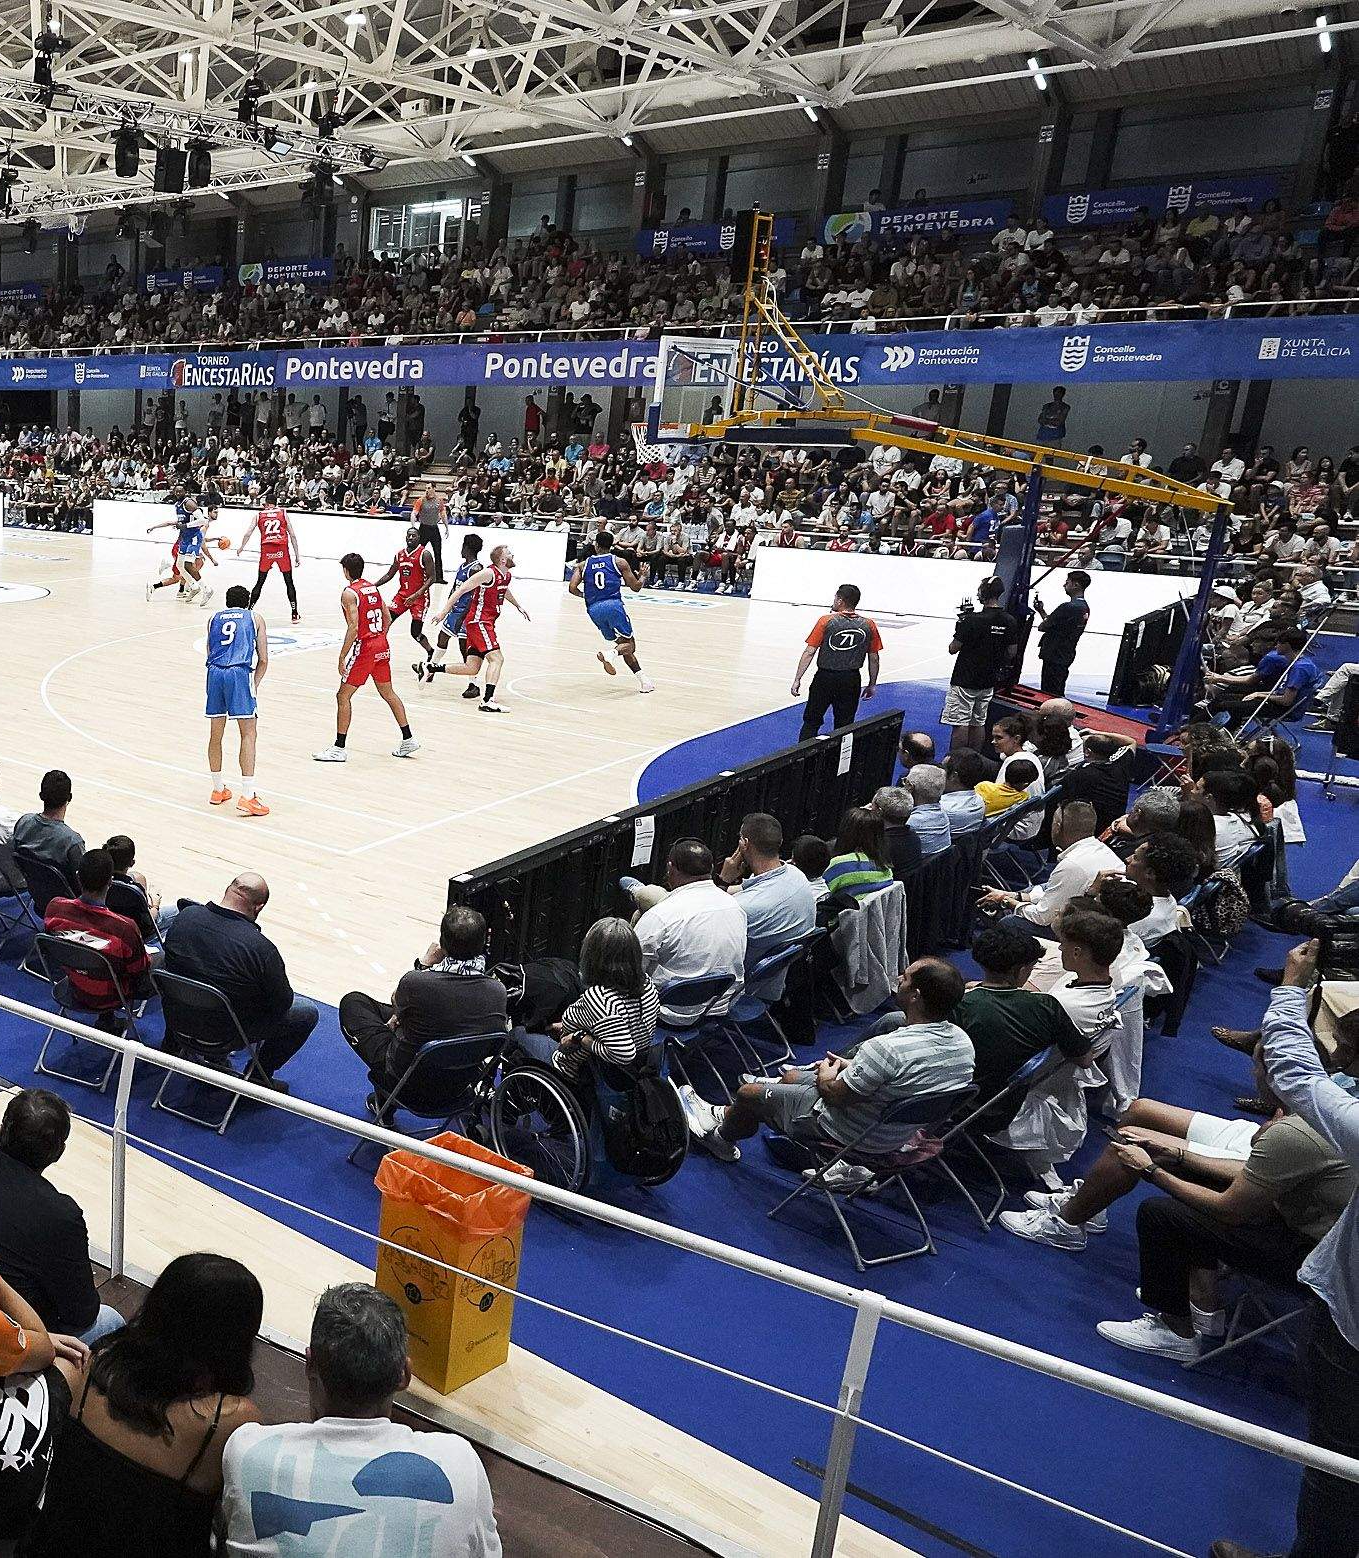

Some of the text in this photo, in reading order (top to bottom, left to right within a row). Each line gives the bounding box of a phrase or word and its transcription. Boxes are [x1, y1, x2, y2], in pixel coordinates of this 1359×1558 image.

[881, 209, 960, 225] DEPORTE
[267, 264, 309, 273] DEPORTE
[1283, 338, 1327, 348] XUNTA
[919, 346, 980, 358] Deputación
[1094, 345, 1136, 354] Concello
[1281, 347, 1351, 357] DE GALICIA
[196, 355, 230, 366] TORNEO
[917, 356, 979, 365] Pontevedra
[1092, 353, 1163, 362] de Pontevedra
[284, 352, 424, 381] Pontevedra
[484, 348, 658, 380] Pontevedra
[263, 519, 281, 535] 22
[594, 571, 605, 590] 0
[367, 608, 383, 633] 33
[220, 620, 237, 646] 9
[839, 633, 855, 646] 71
